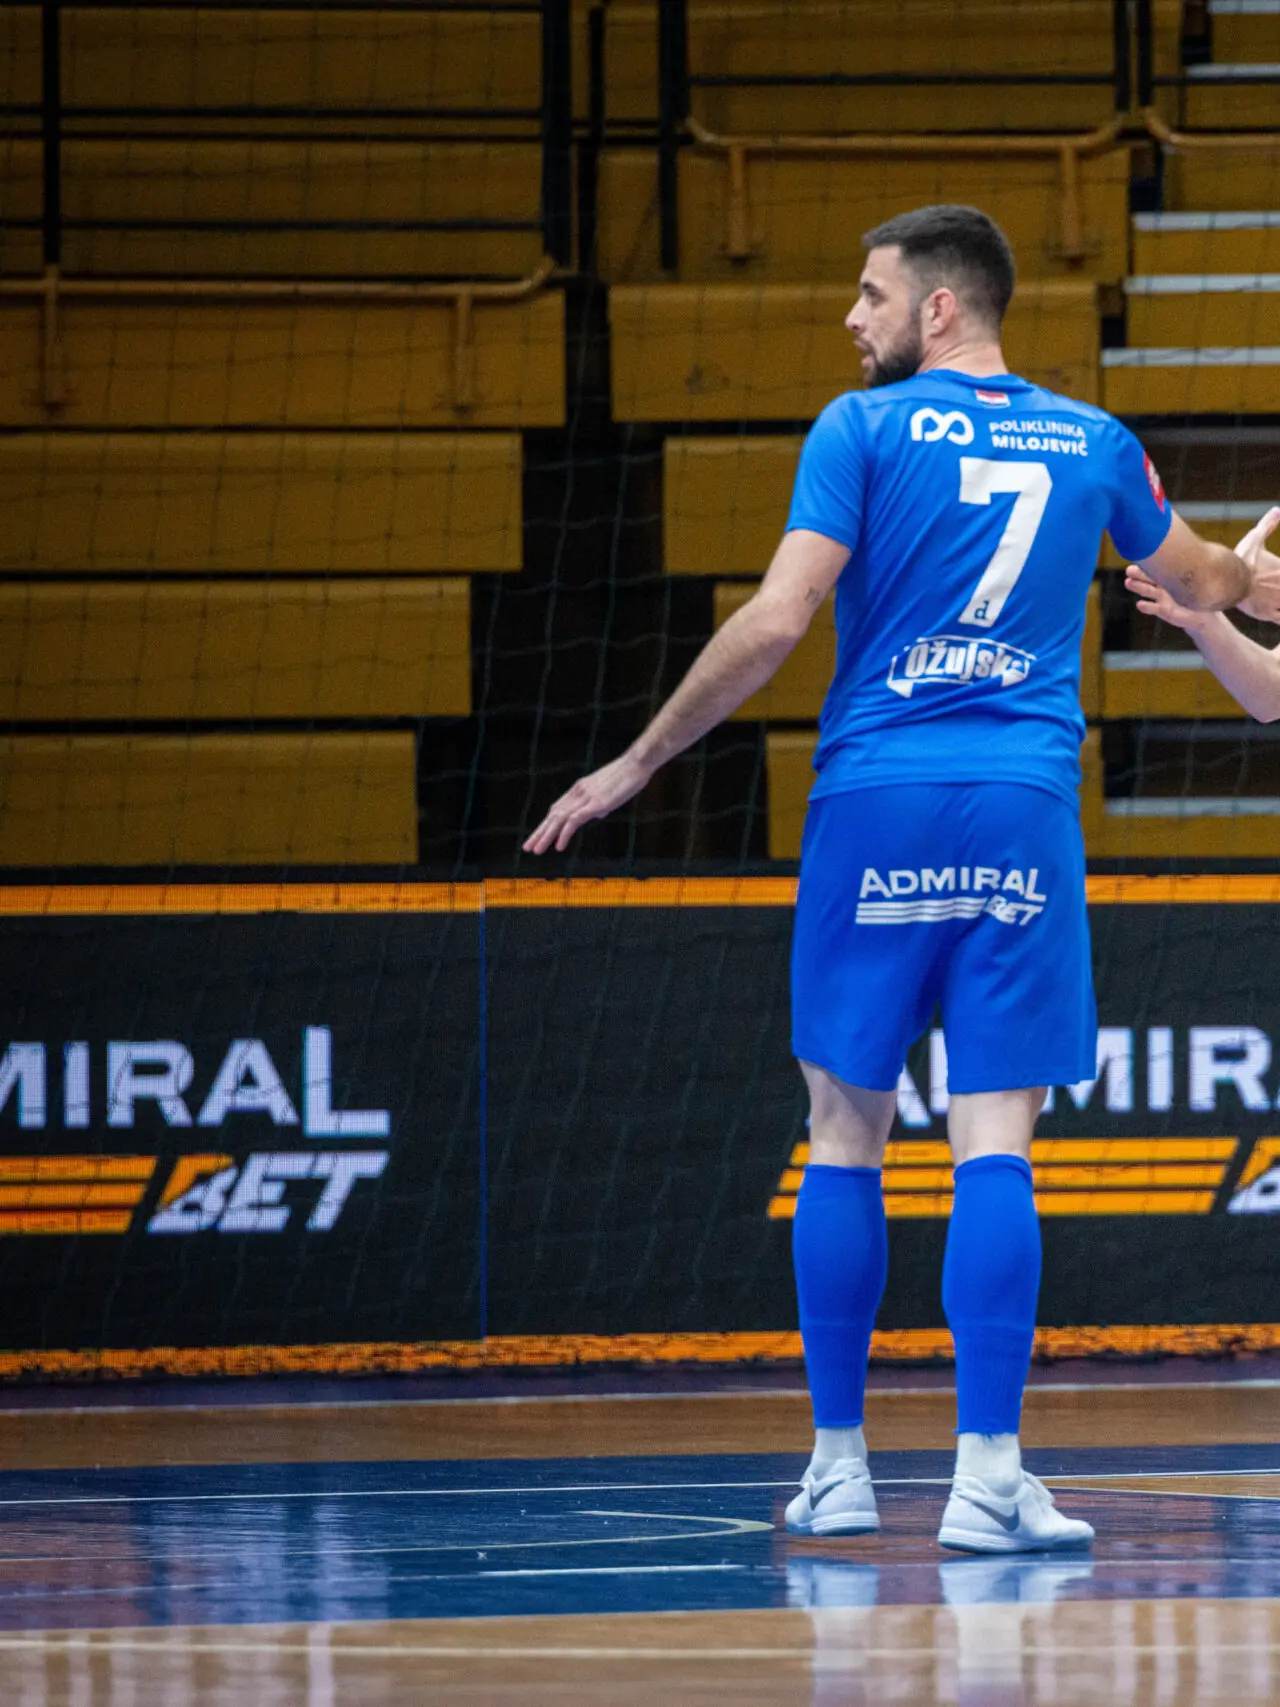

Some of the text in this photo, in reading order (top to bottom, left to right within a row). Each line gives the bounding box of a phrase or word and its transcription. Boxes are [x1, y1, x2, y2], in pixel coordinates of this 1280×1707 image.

[988, 420, 1087, 439] POLIKLINIKA
[991, 435, 1089, 457] MILOJEVIĆ
[958, 456, 1053, 629] 7
[859, 866, 1047, 902] ADMIRAL
[984, 894, 1044, 927] BET
[146, 1150, 390, 1235] BET
